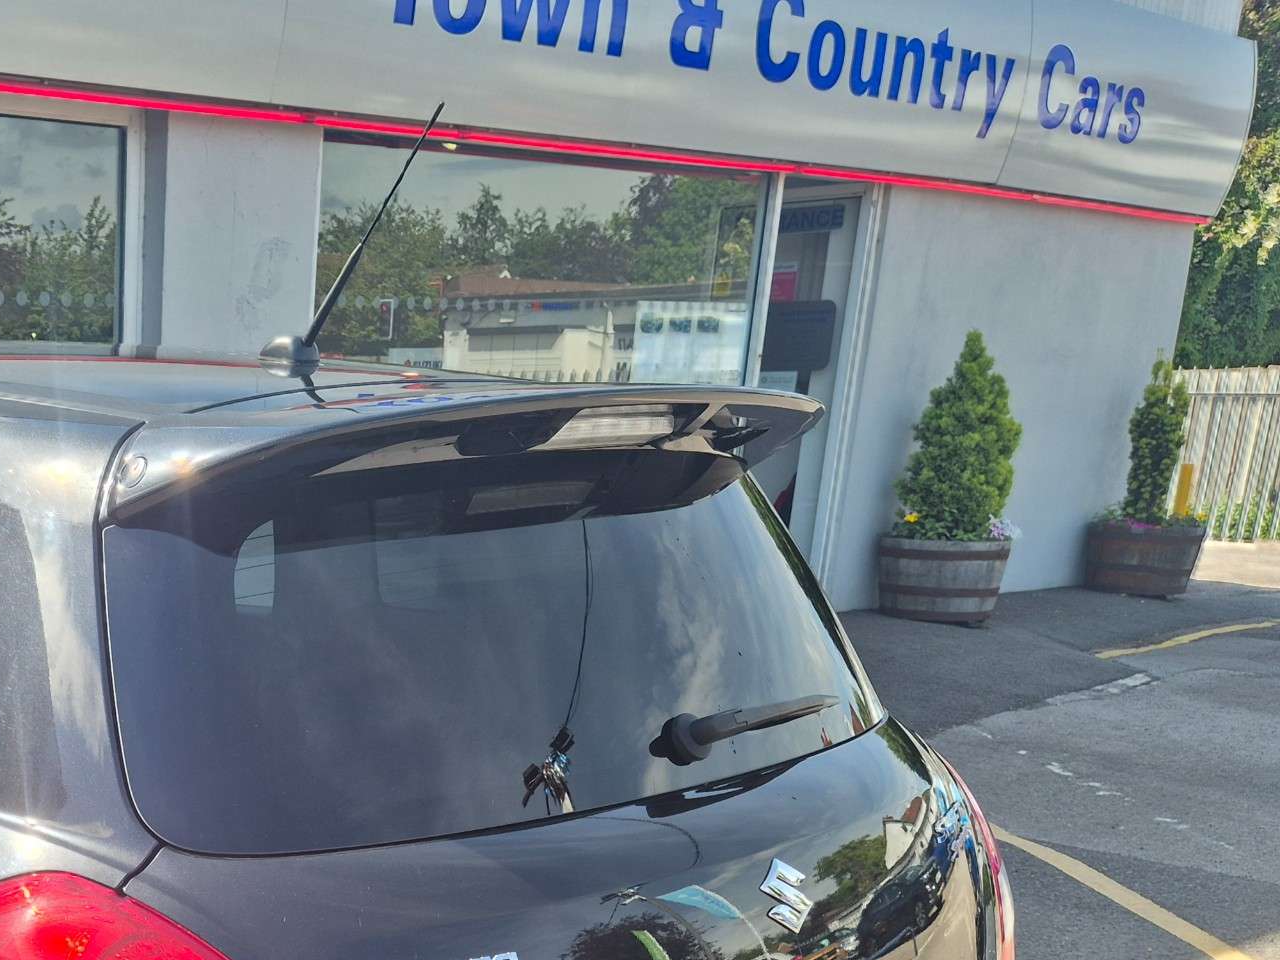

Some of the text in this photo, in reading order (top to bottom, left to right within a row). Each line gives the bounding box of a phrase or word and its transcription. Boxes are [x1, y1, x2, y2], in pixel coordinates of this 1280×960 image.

[393, 0, 629, 57] wn
[756, 0, 1015, 139] Country
[1038, 44, 1146, 144] Cars
